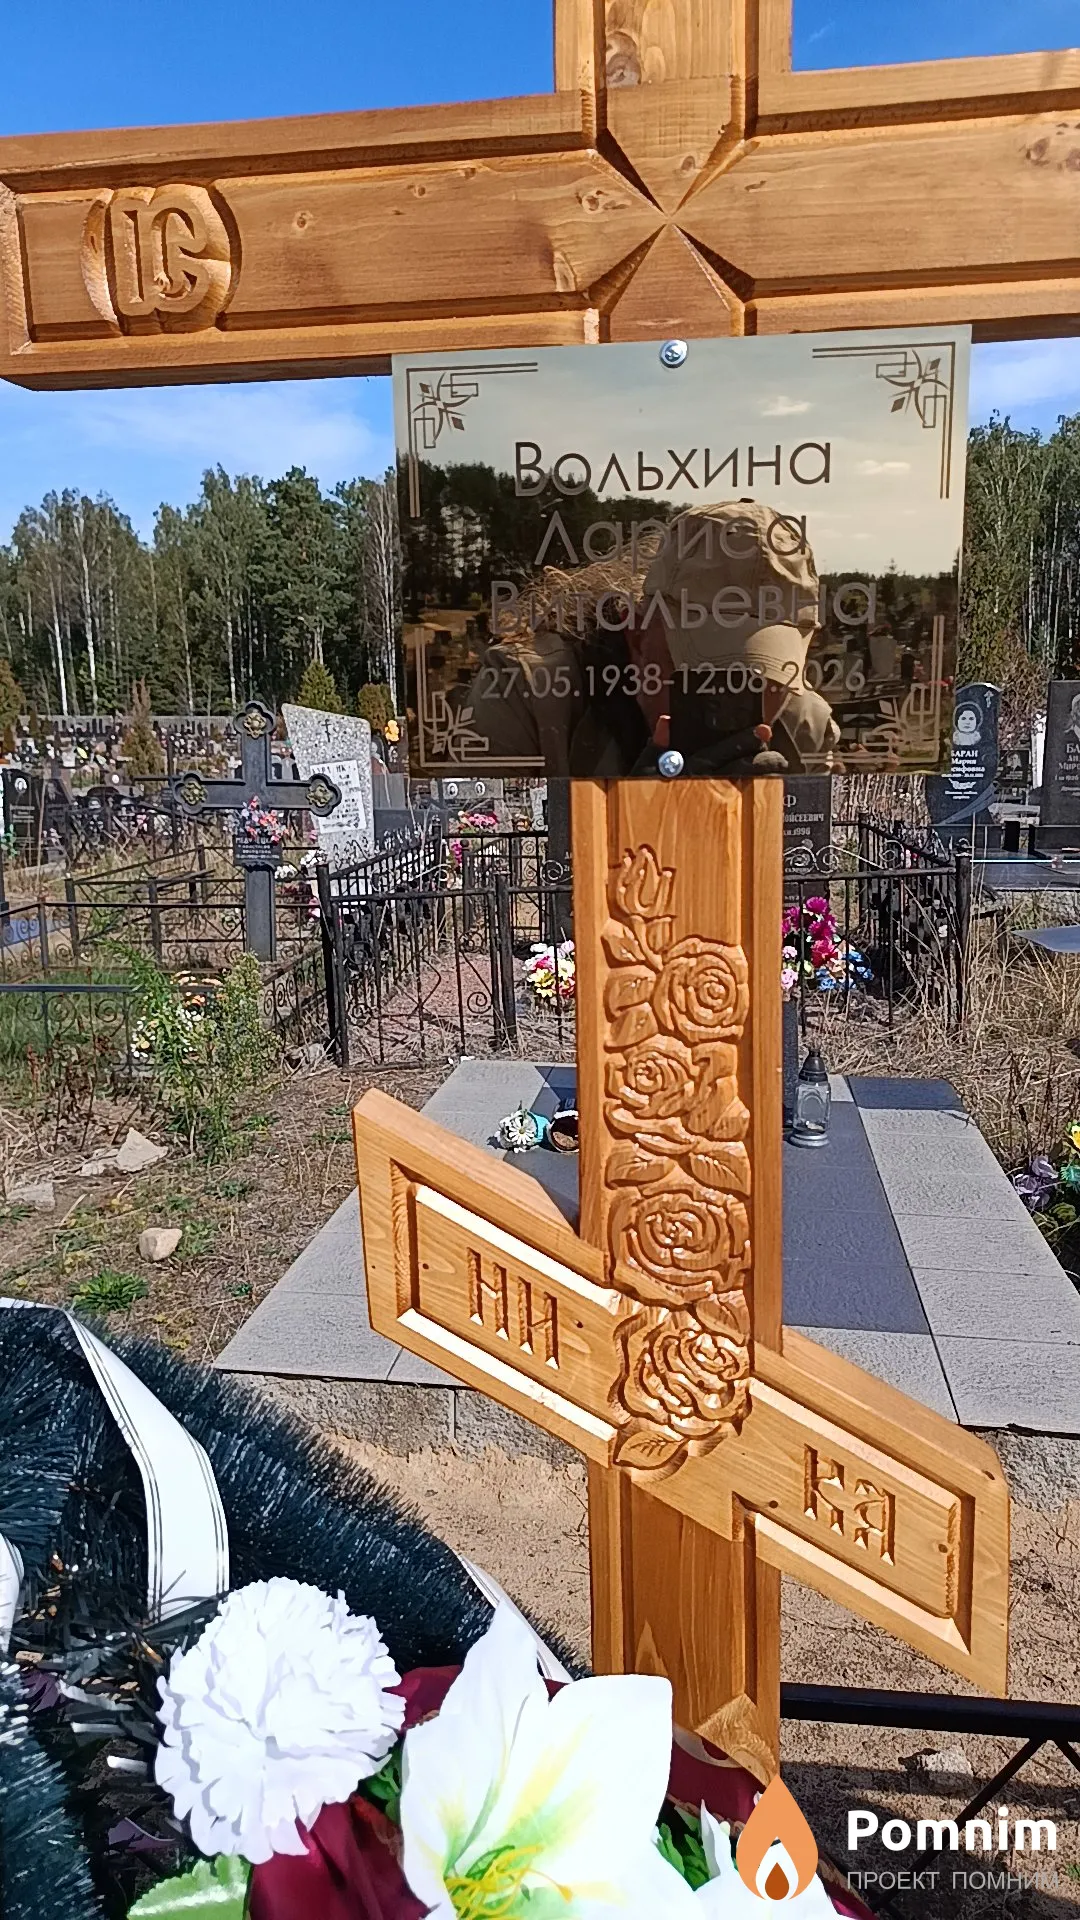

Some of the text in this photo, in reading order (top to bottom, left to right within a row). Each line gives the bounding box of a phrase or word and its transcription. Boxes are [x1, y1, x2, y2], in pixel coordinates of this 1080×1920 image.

[514, 440, 831, 497] Вольхина
[533, 509, 807, 575] Лариса
[490, 580, 877, 635] Витальевна
